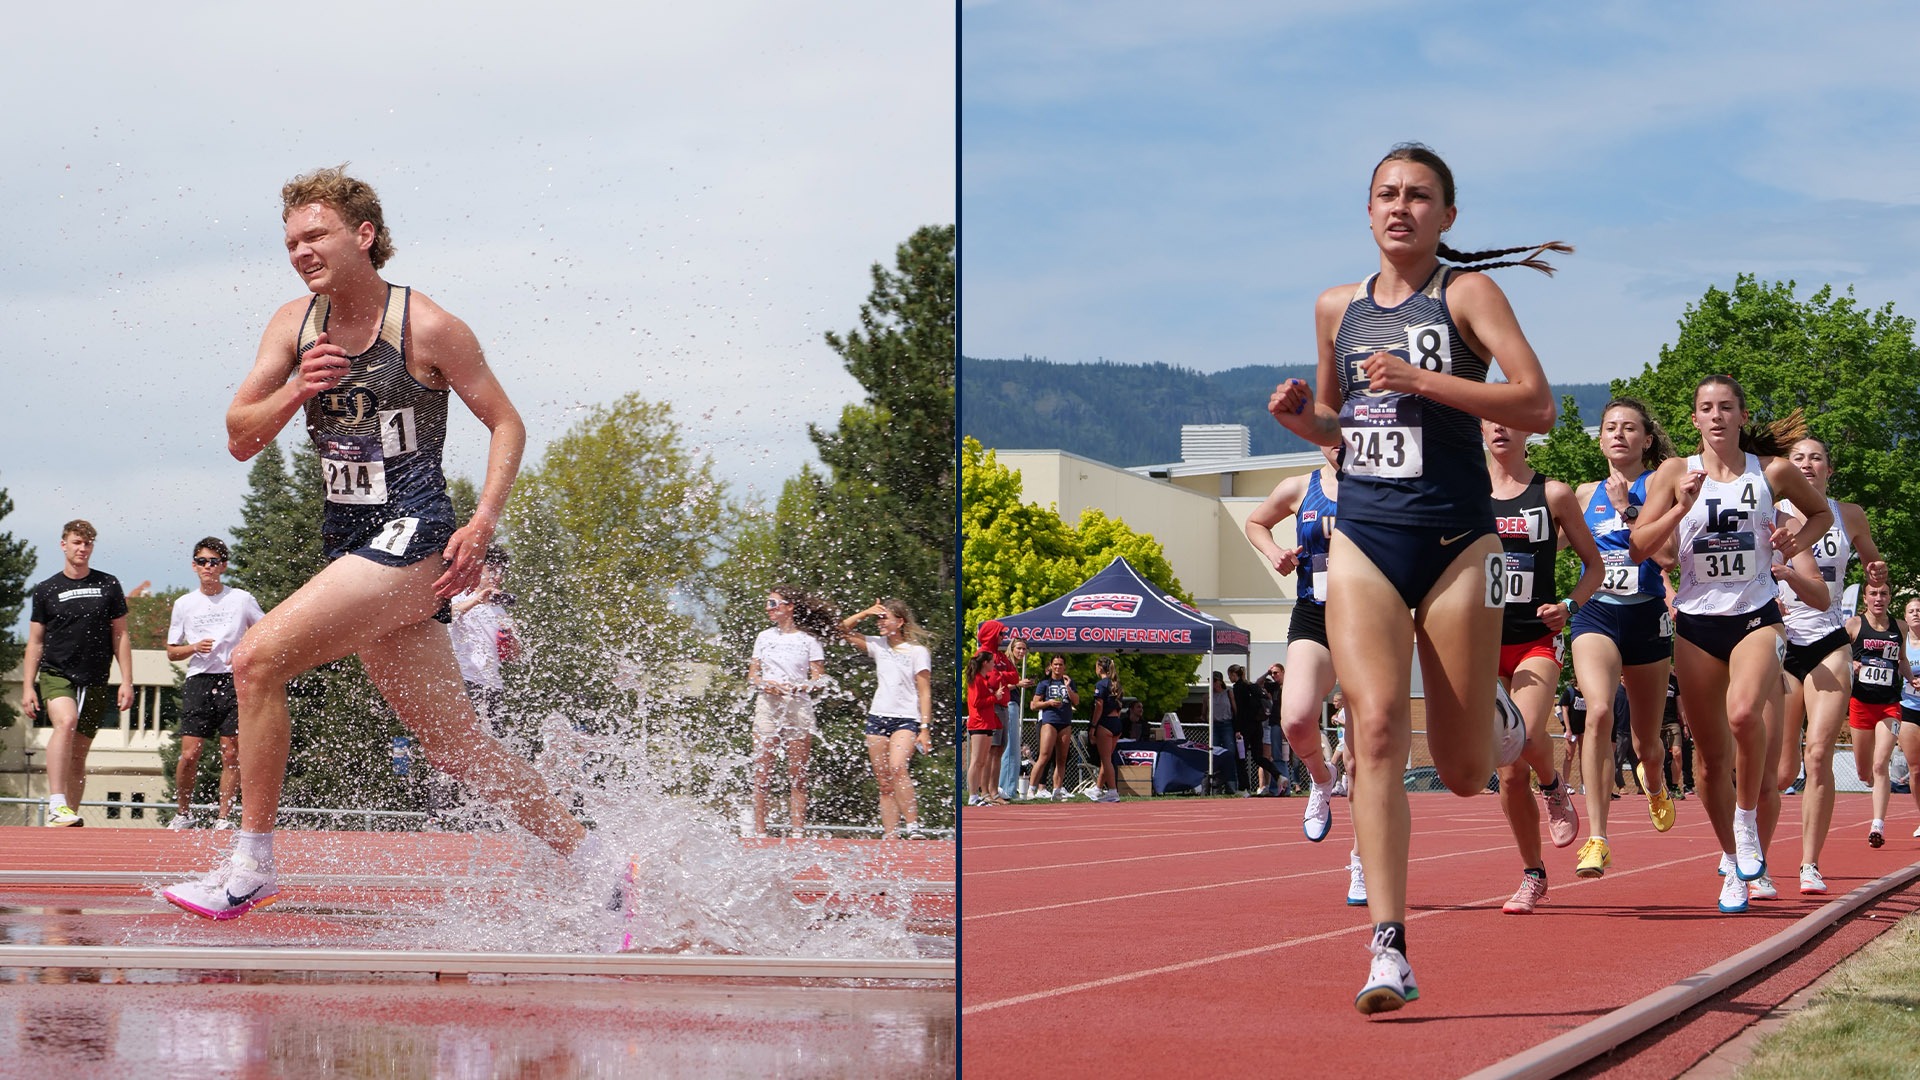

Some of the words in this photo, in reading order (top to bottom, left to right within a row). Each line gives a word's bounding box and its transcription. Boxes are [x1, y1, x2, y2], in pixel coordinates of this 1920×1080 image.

[1416, 329, 1443, 373] 8
[389, 412, 407, 452] 1
[1351, 431, 1405, 468] 243
[328, 463, 373, 495] 214
[1741, 483, 1757, 510] 4
[1495, 516, 1529, 534] DER
[1528, 510, 1543, 540] 7
[1823, 532, 1837, 557] 6
[1705, 553, 1746, 577] 314
[1490, 556, 1503, 606] 8
[1506, 573, 1523, 597] 0
[1602, 569, 1629, 590] 32
[1001, 626, 1077, 642] CASCADE
[1079, 627, 1191, 644] CONFERENCE
[1886, 646, 1899, 659] 14
[1865, 667, 1888, 682] 404
